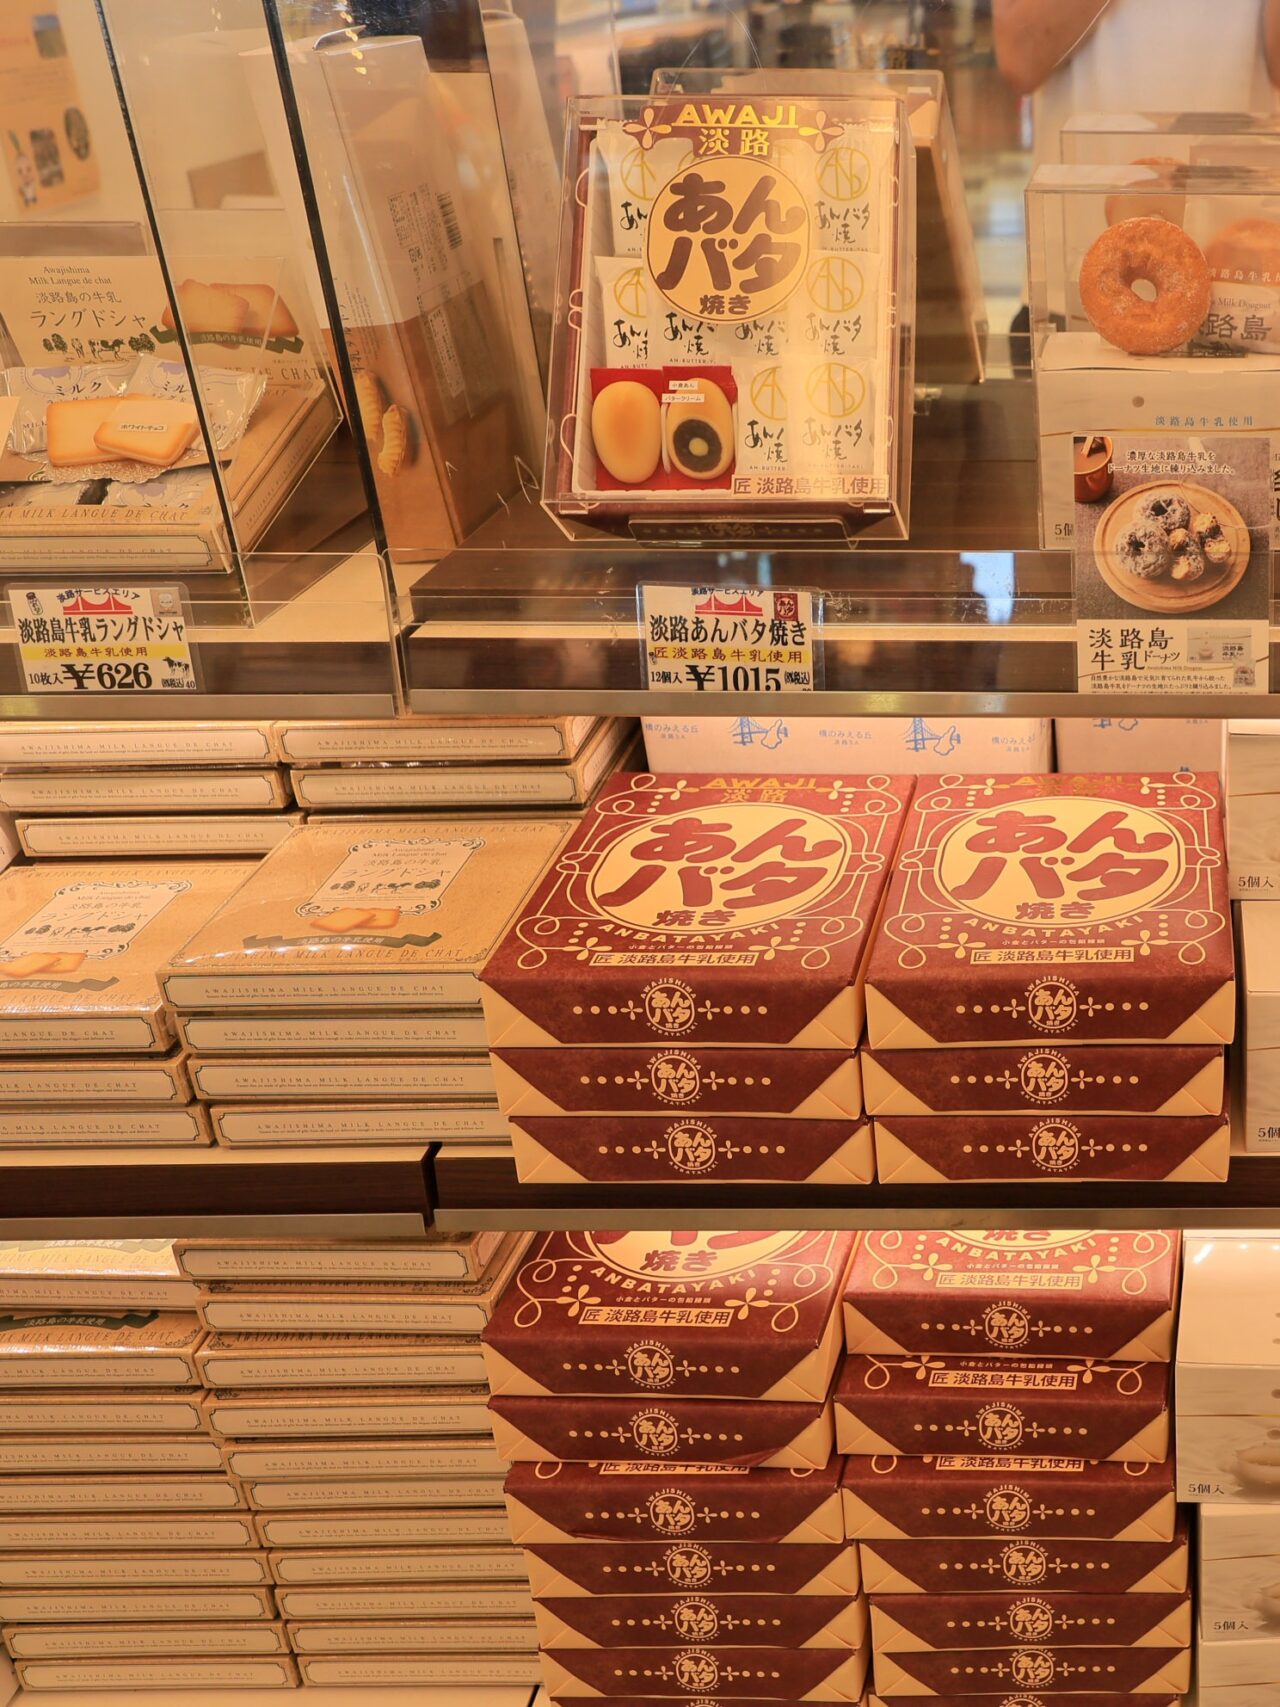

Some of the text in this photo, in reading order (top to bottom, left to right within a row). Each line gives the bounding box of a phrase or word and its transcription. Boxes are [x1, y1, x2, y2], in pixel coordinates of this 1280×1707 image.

[672, 103, 799, 127] AWAJI
[698, 127, 770, 157] 淡路
[663, 172, 806, 235] あん
[655, 233, 802, 294] バタ
[29, 276, 48, 285] Milk
[51, 276, 81, 287] Langue
[35, 292, 121, 304] 淡路島の牛乳
[699, 294, 751, 316] 焼き
[30, 310, 146, 328] ラングドシャ
[1155, 415, 1254, 427] 淡路島牛乳使用
[757, 477, 887, 495] 淡路島牛乳使用
[22, 508, 189, 521] MILK LANGUE DE CHAT
[18, 616, 185, 644] 淡路島牛乳ラングドシャ
[650, 615, 806, 646] 淡路あんバタ焼き
[1089, 627, 1174, 649] 淡路島
[44, 647, 148, 658] 淡路島牛乳使用
[654, 647, 802, 663] 匠淡路島牛乳使用
[1091, 650, 1180, 671] 牛乳ドーナツ
[29, 663, 153, 690] 10枚入 ¥626
[651, 665, 781, 691] 12個入 ¥1015
[700, 777, 817, 790] AWAJI
[721, 789, 789, 802] 淡路
[630, 817, 843, 863] あん
[965, 811, 1174, 854] あん
[597, 861, 828, 909] バタ
[950, 852, 1169, 901] バタ
[1237, 876, 1274, 889] 5個入
[652, 910, 736, 926] 焼き
[1015, 902, 1096, 920] 焼き
[598, 922, 781, 943] ANBATAYAKI
[963, 915, 1145, 937] ANBATAYAKI
[593, 954, 755, 965] 匠 淡路島牛乳使用
[640, 978, 696, 999] AWAJISHIMA
[651, 991, 690, 1008] あん
[652, 1007, 691, 1023] バタ
[591, 1267, 756, 1293] ANBATAYAKI
[582, 1309, 730, 1324] 匠 淡路島牛乳使用
[932, 1373, 1074, 1387] 匠 淡路島牛乳使用
